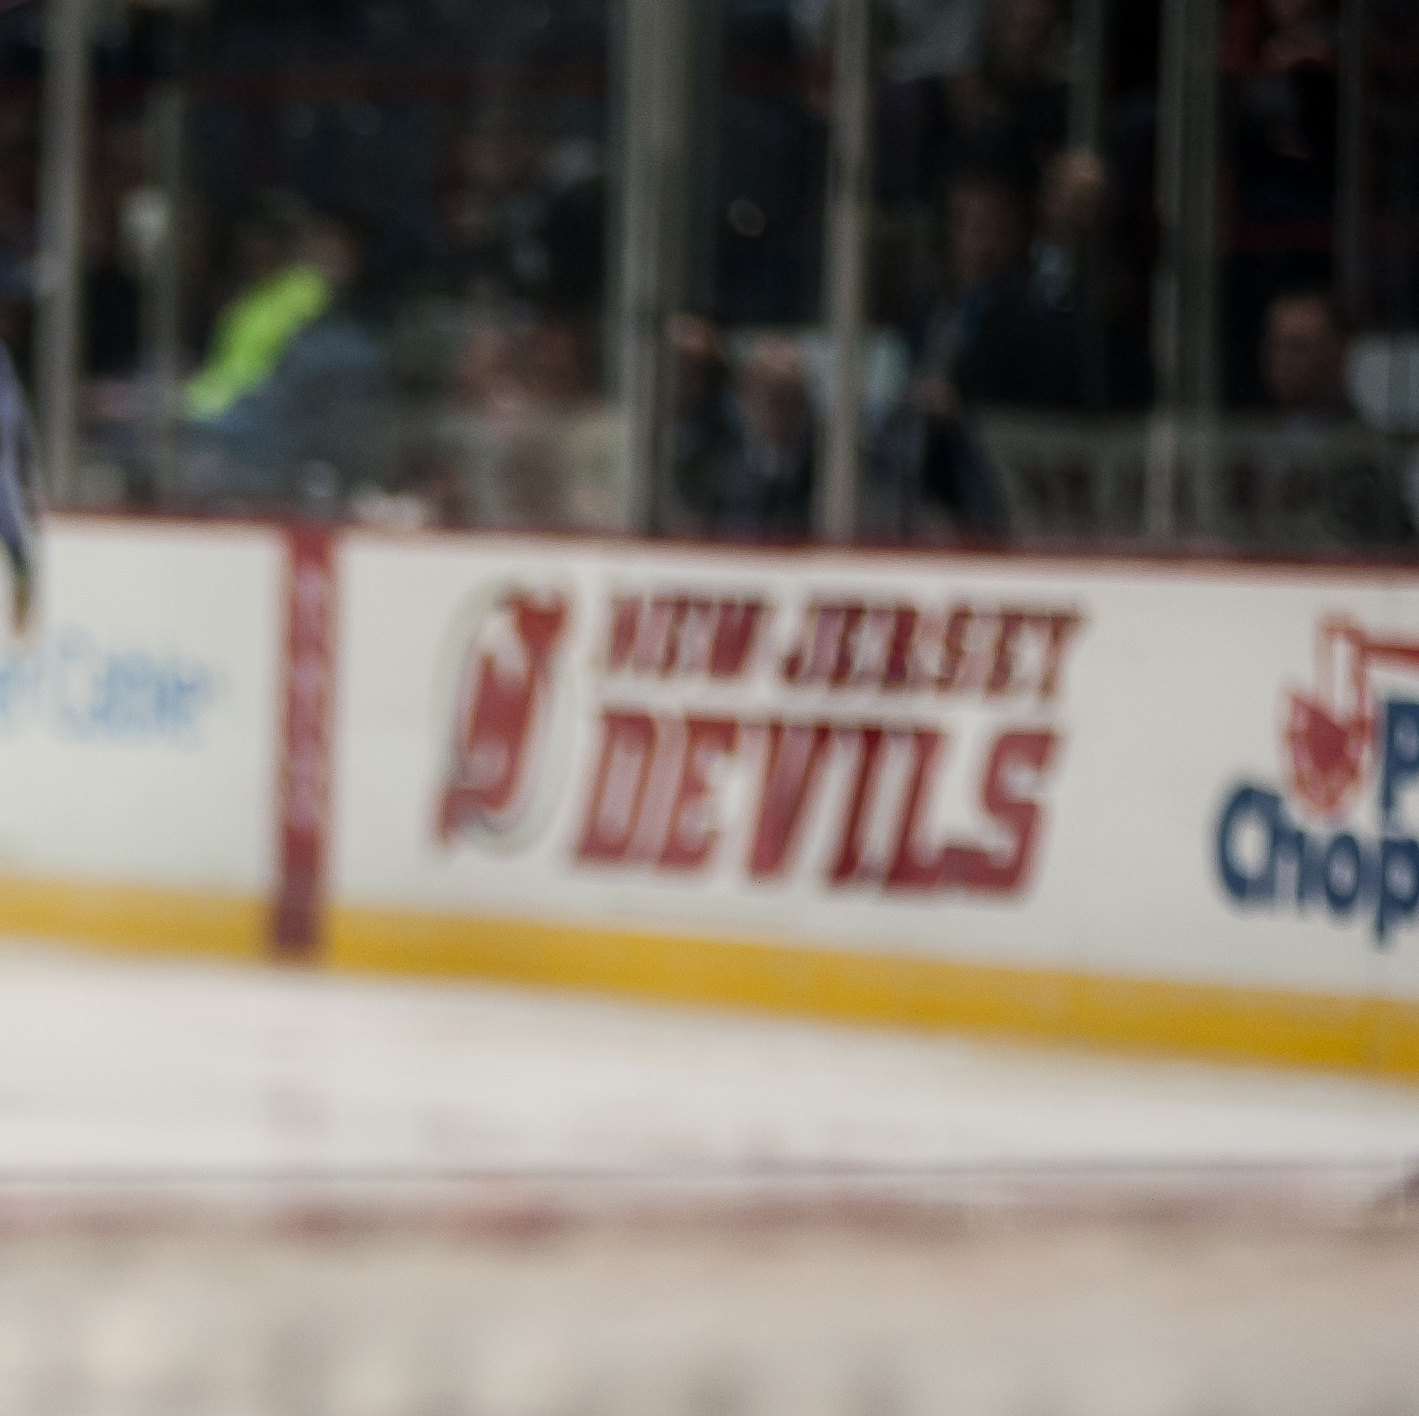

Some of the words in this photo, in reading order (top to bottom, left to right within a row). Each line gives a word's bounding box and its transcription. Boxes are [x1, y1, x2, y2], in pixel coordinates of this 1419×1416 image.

[603, 596, 769, 680] NEW
[775, 602, 1080, 696] JERSEY
[571, 710, 1059, 890] DEVILS
